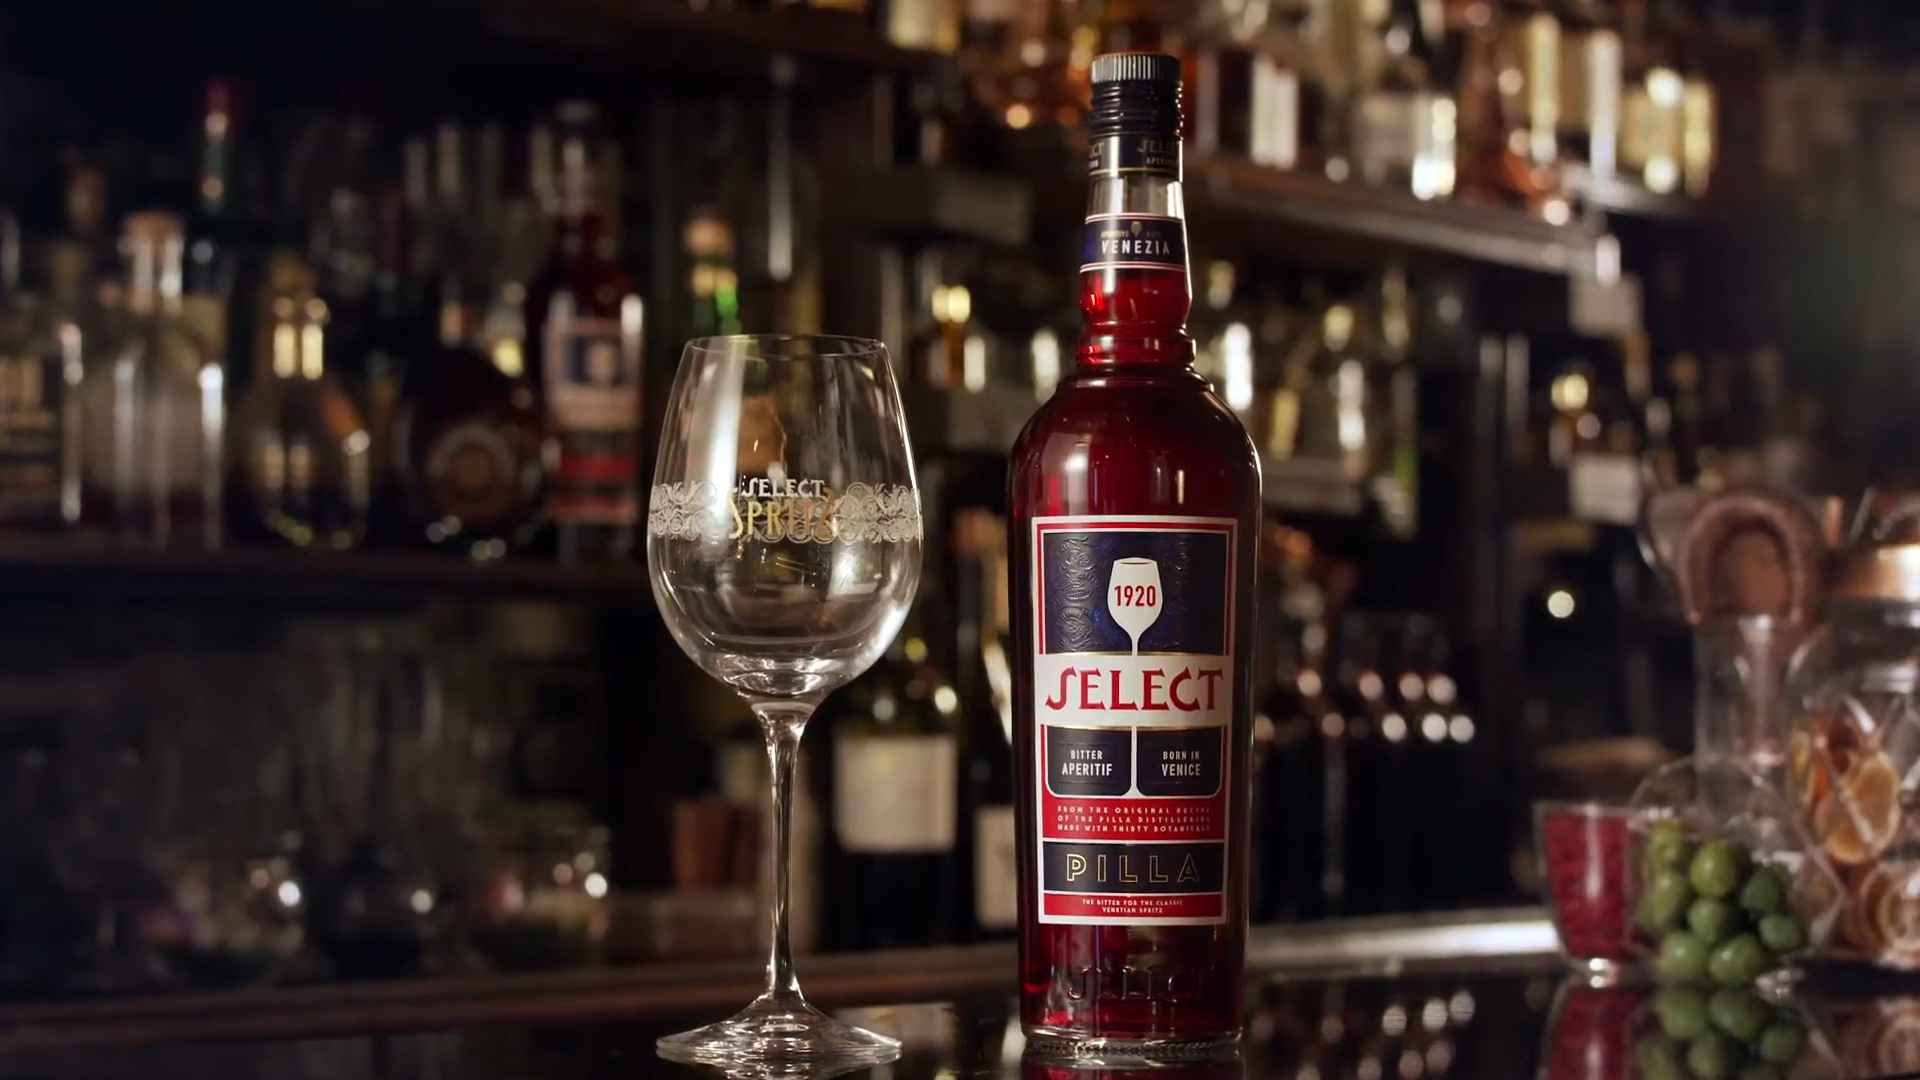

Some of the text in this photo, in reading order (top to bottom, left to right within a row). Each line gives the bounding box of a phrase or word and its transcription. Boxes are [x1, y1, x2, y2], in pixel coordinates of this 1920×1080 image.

[1101, 240, 1170, 255] VENEZIA
[741, 477, 824, 498] SELECT
[1114, 585, 1157, 608] 1920
[1045, 665, 1224, 711] SELECT
[1070, 750, 1103, 760] BITTER
[1162, 751, 1200, 760] BORN IN
[1061, 763, 1113, 776] APERITIF
[1161, 764, 1201, 776] VENICE
[1057, 805, 1083, 813] FROM
[1089, 806, 1108, 814] THE
[1057, 815, 1069, 823] OF
[1075, 815, 1093, 823] THE
[1066, 852, 1200, 883] PILLA
